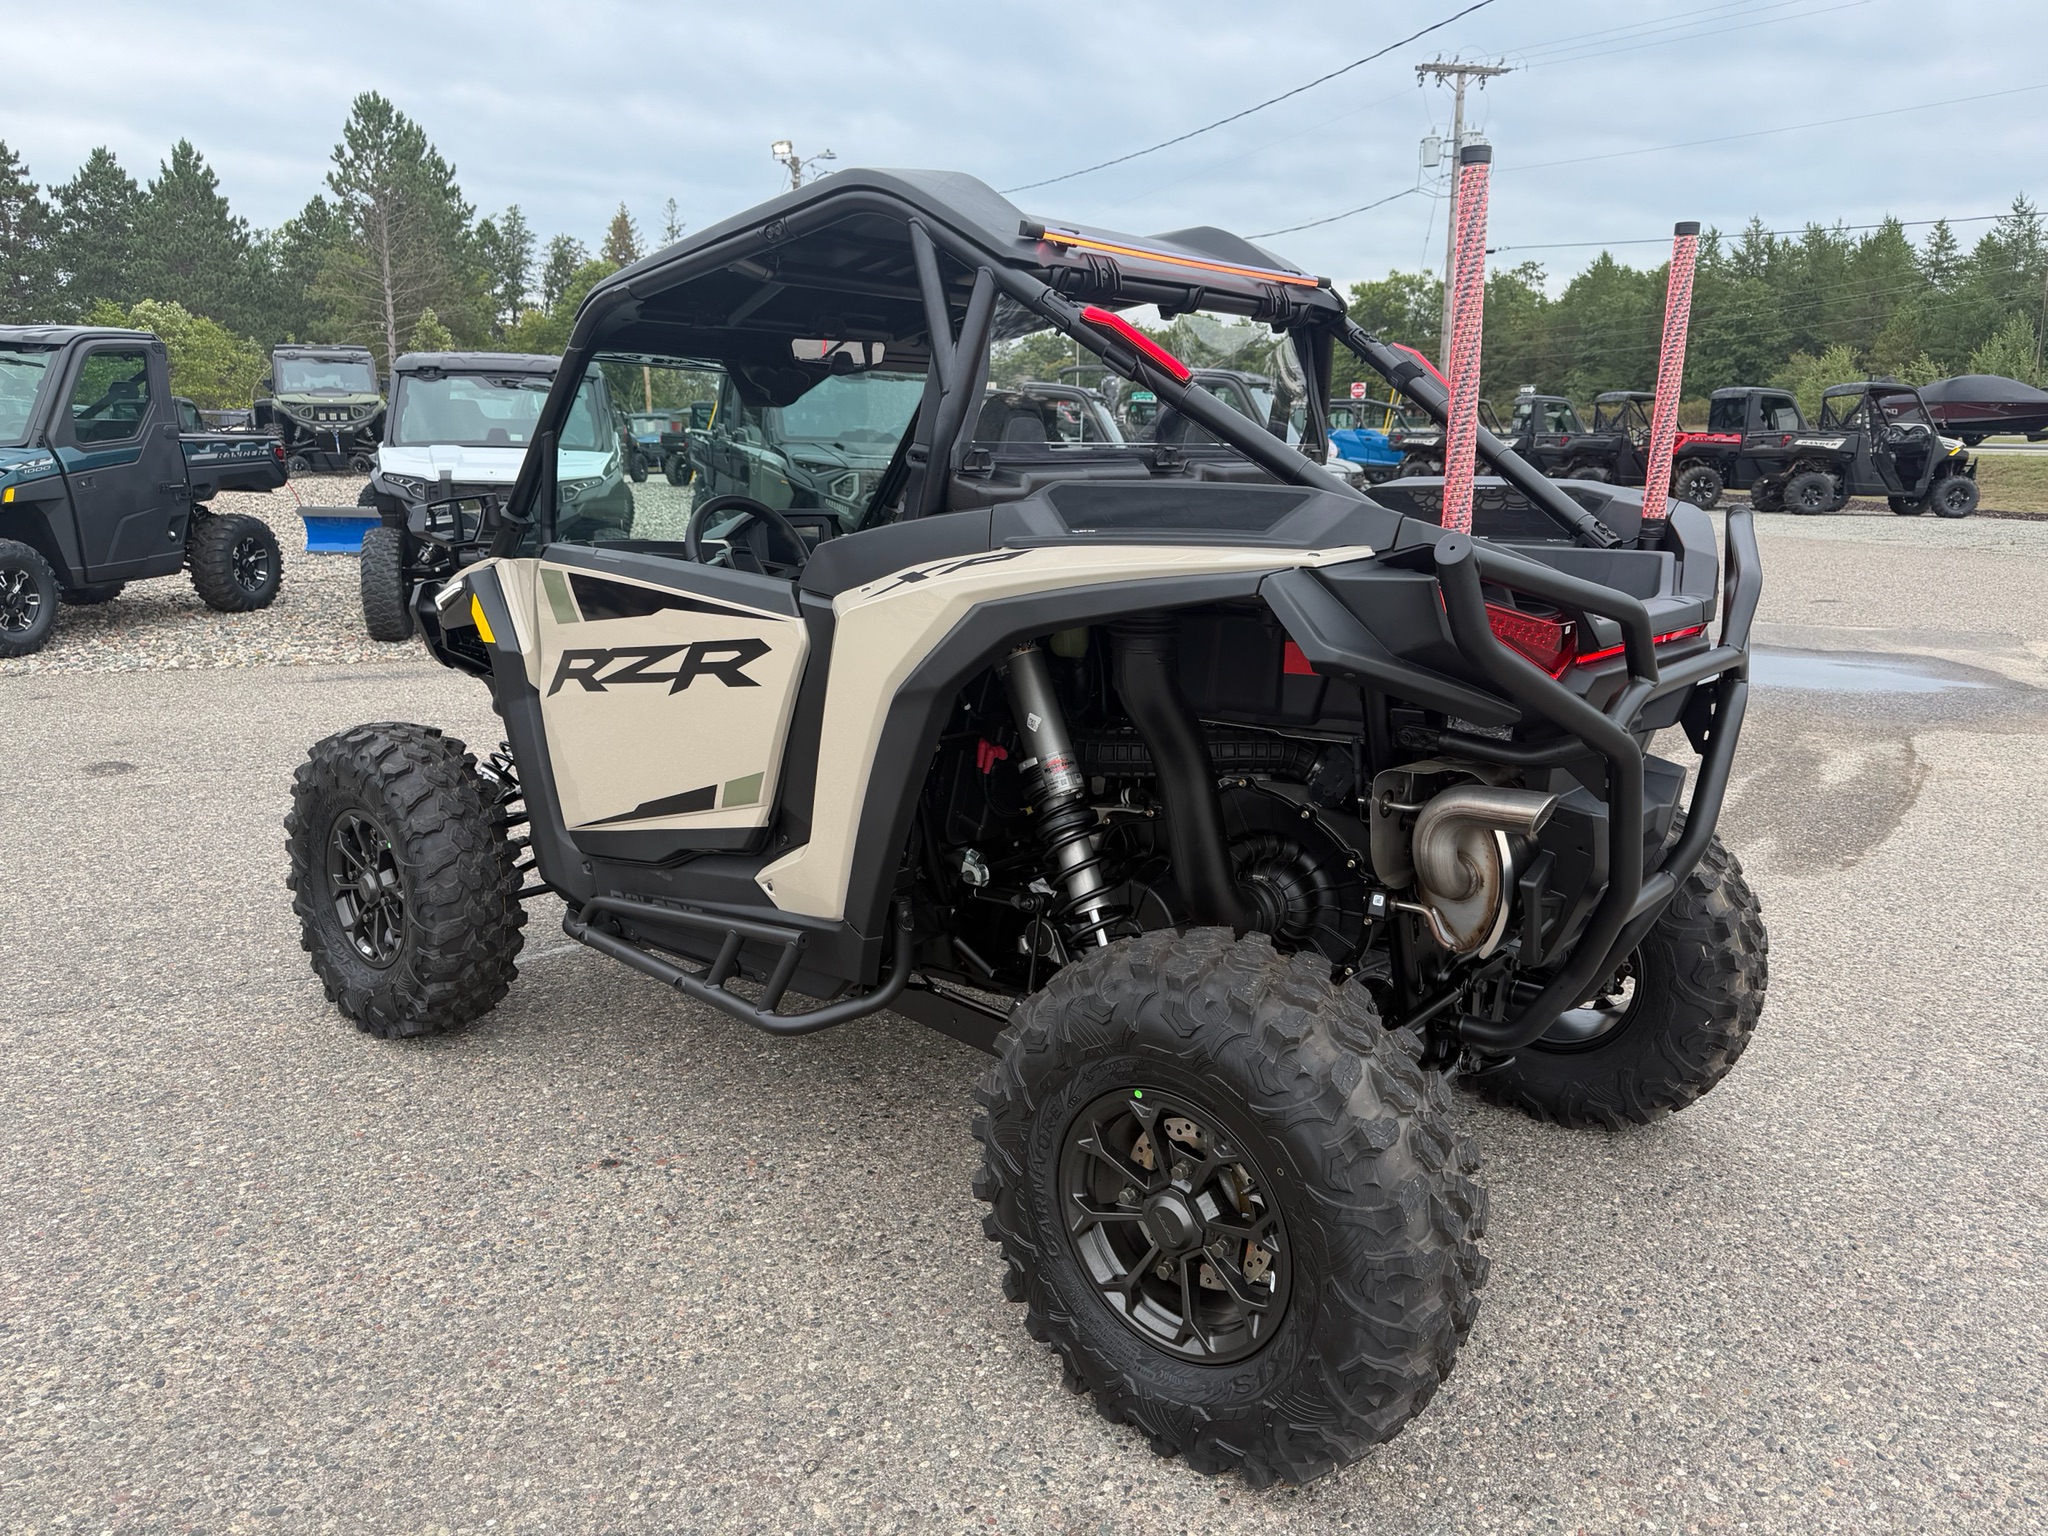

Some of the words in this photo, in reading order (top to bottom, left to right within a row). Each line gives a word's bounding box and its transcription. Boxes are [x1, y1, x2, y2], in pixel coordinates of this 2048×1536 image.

[217, 449, 269, 459] RANGER
[17, 458, 51, 469] XP
[24, 465, 51, 475] 1000
[546, 638, 772, 697] RZR
